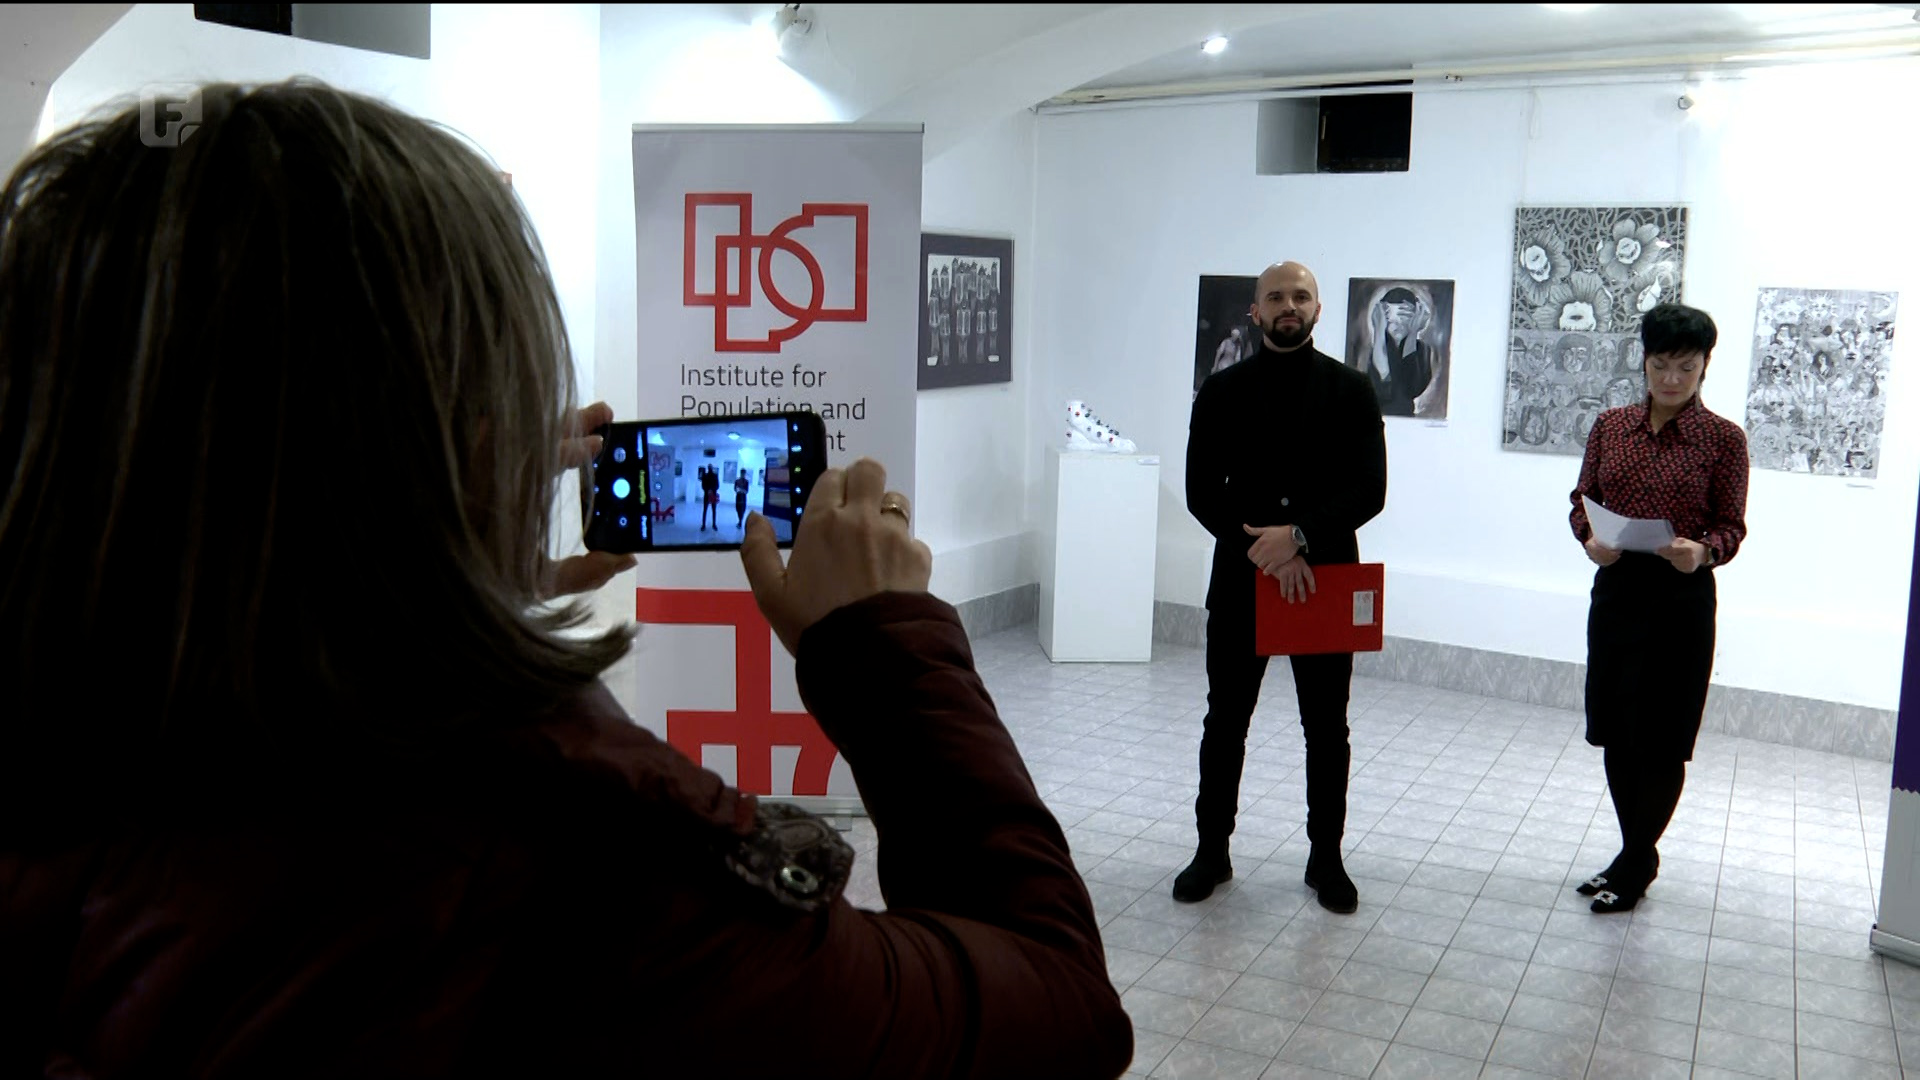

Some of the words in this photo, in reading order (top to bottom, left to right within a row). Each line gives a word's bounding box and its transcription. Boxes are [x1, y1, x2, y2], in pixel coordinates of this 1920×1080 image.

[681, 363, 784, 388] Institute
[792, 363, 827, 388] for
[821, 398, 866, 420] and
